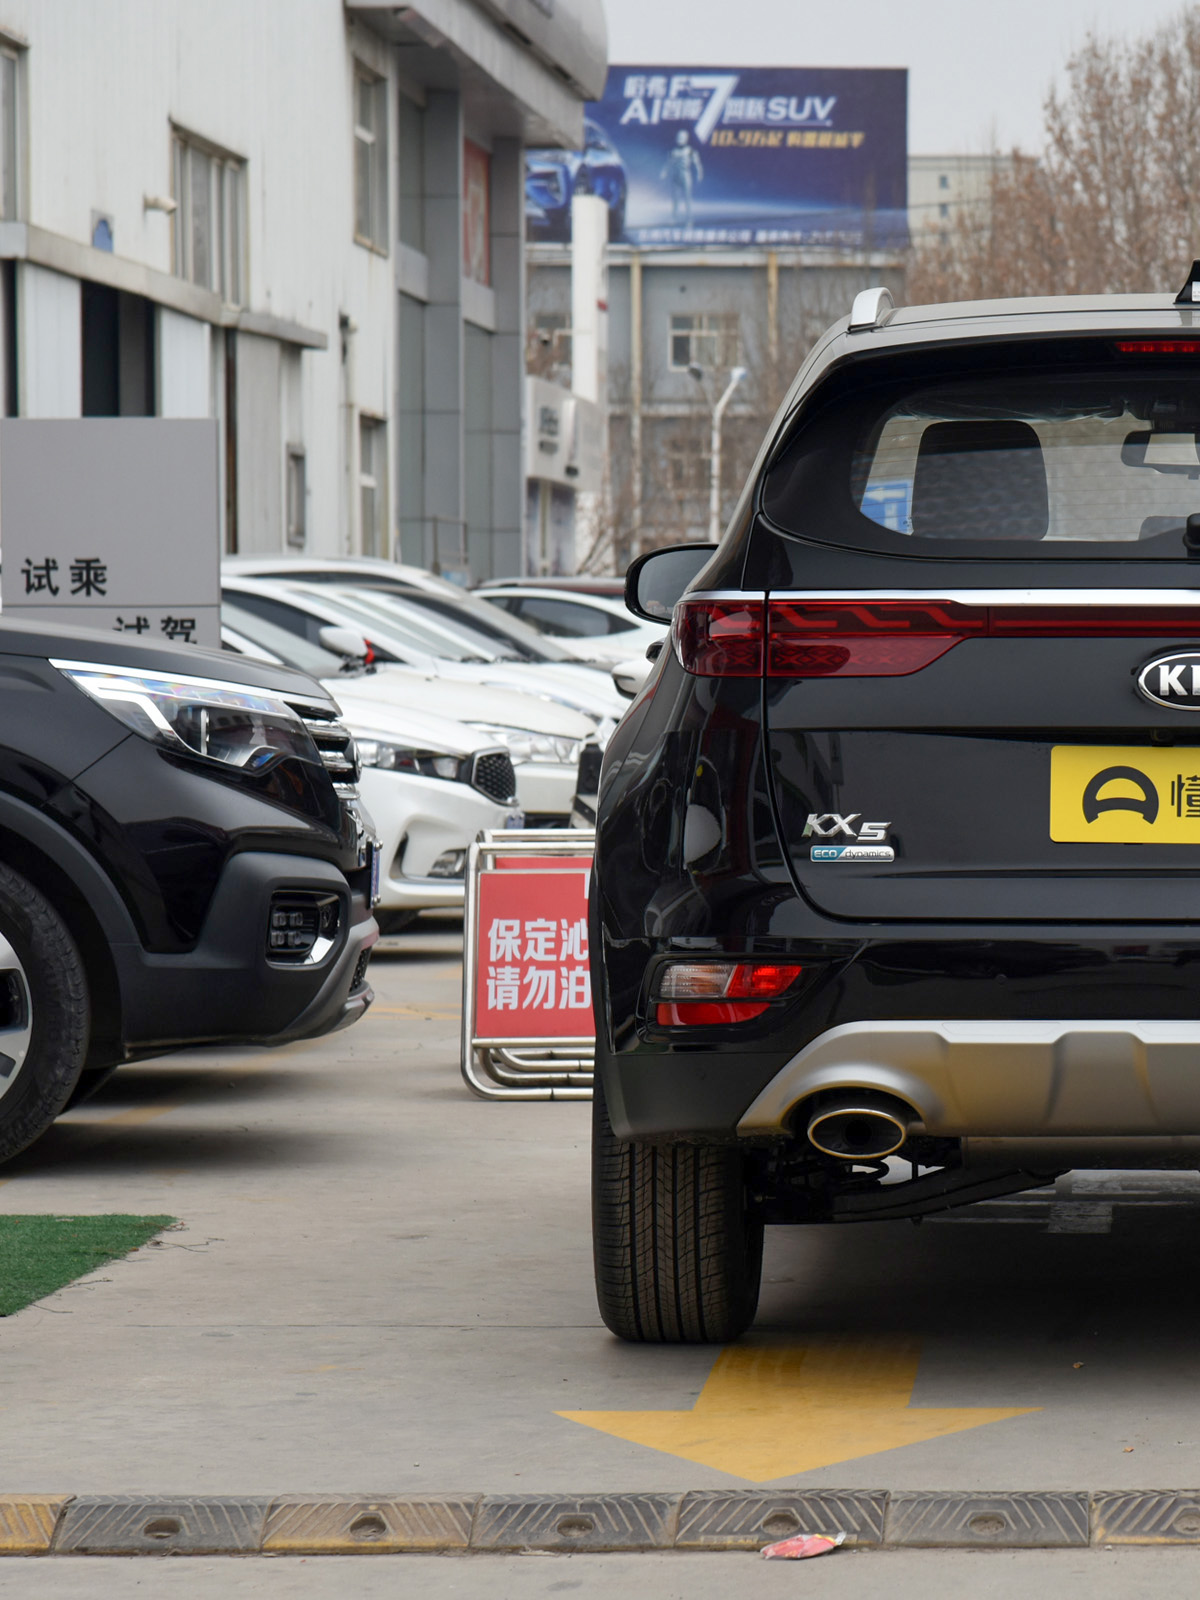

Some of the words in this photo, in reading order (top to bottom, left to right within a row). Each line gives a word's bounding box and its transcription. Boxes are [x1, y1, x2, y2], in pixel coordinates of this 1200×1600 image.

[21, 558, 107, 597] 试乘
[814, 849, 837, 858] ECO
[845, 849, 891, 859] dynamics
[486, 965, 592, 1010] 请勿泊
